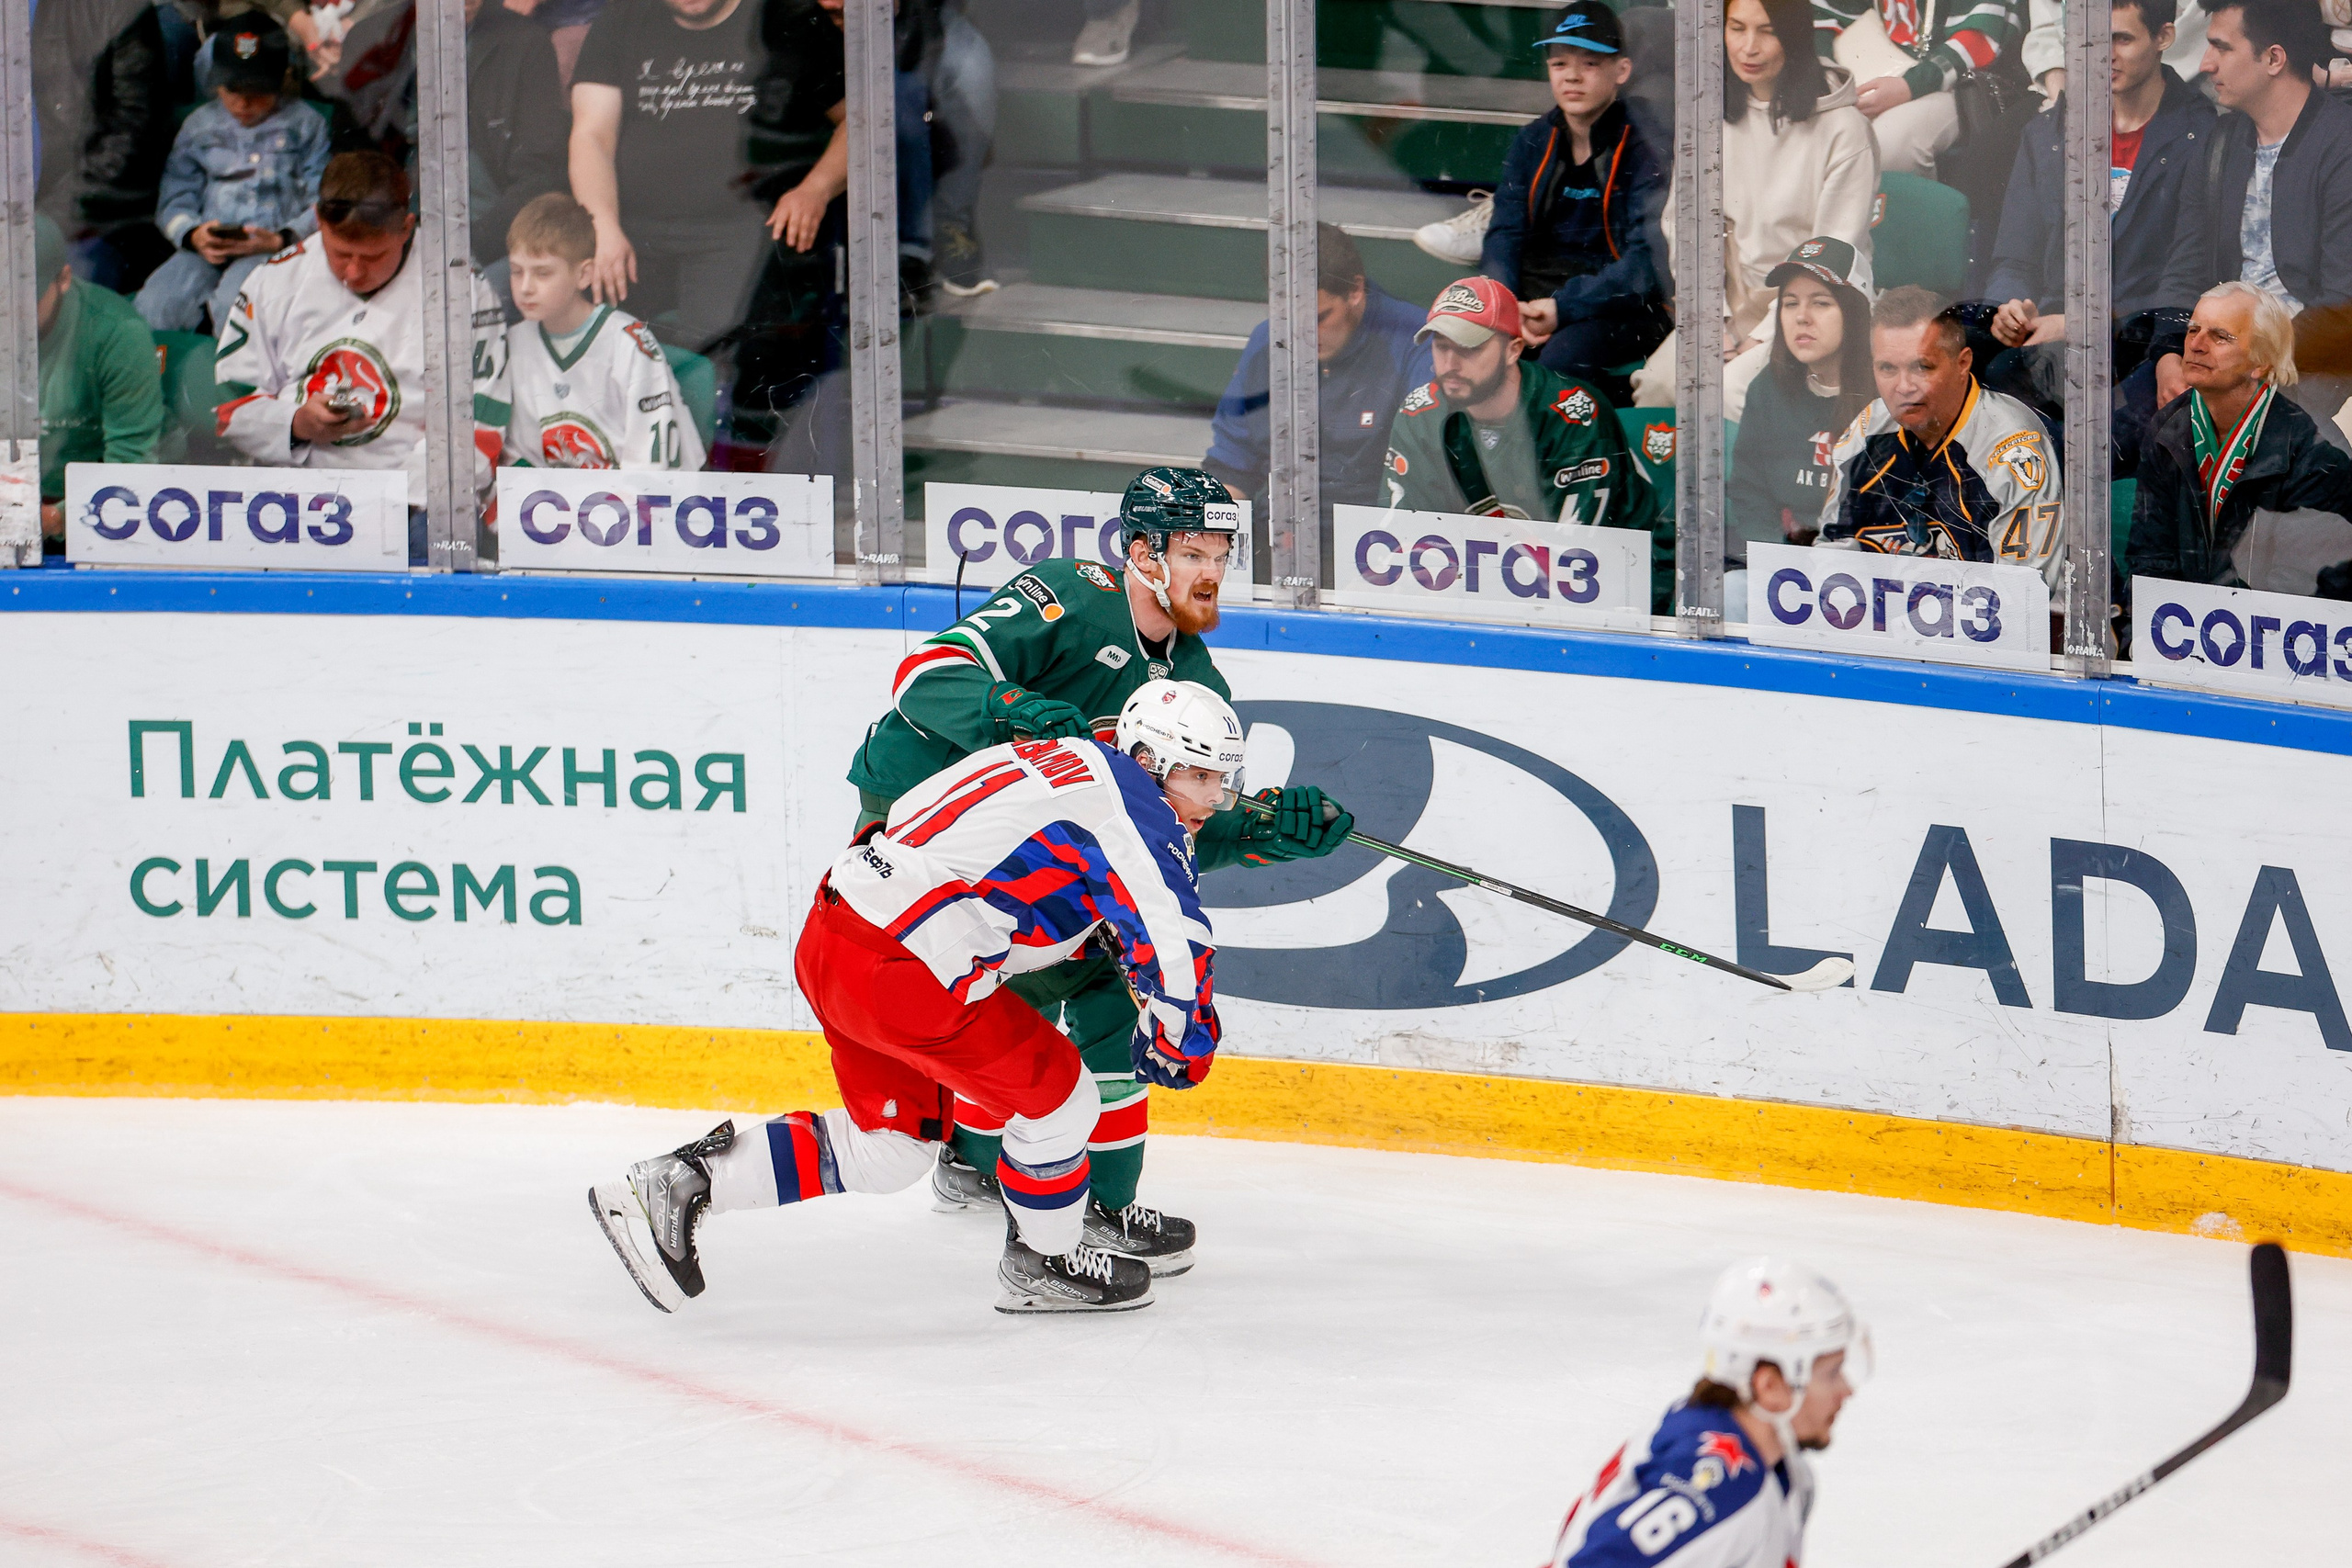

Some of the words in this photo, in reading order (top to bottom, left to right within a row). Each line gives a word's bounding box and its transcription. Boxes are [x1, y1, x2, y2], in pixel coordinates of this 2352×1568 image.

[947, 507, 1125, 568] сог
[1999, 502, 2062, 560] 47
[964, 596, 1023, 633] 2
[1222, 716, 1238, 735] 11
[129, 719, 747, 813] Платёжная
[130, 856, 583, 926] система
[1659, 942, 1708, 963] CCM
[1732, 804, 2352, 1053] LADA
